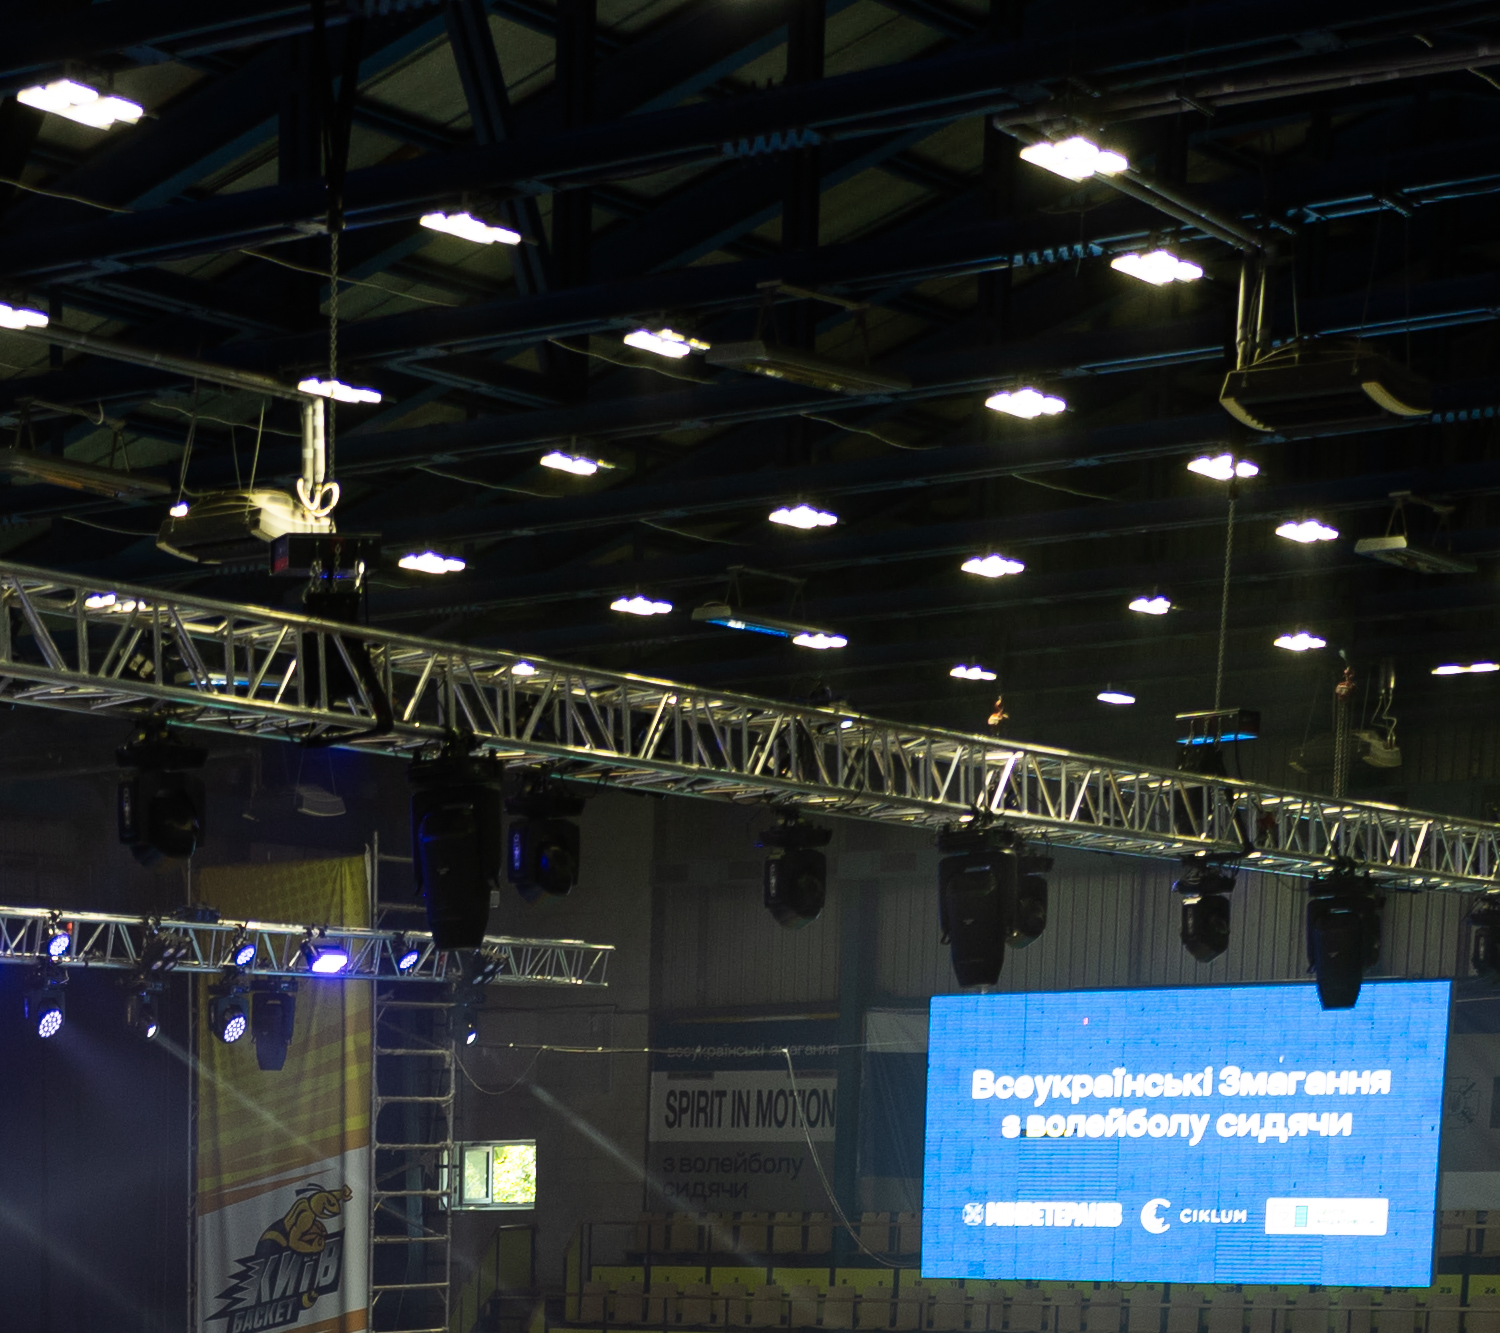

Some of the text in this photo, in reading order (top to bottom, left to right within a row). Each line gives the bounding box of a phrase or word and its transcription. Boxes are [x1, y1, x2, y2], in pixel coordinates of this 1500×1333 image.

[972, 1066, 1391, 1107] Всеукраїнські Змагання
[665, 1087, 836, 1128] SPIRIT IN MOTION
[1026, 1109, 1209, 1146] волейболу
[1216, 1112, 1352, 1143] сидячи
[680, 1151, 805, 1180] волейболу
[662, 1180, 748, 1201] сидячи
[1180, 1207, 1247, 1224] CIKLUM
[255, 1240, 342, 1304] КИЇВ
